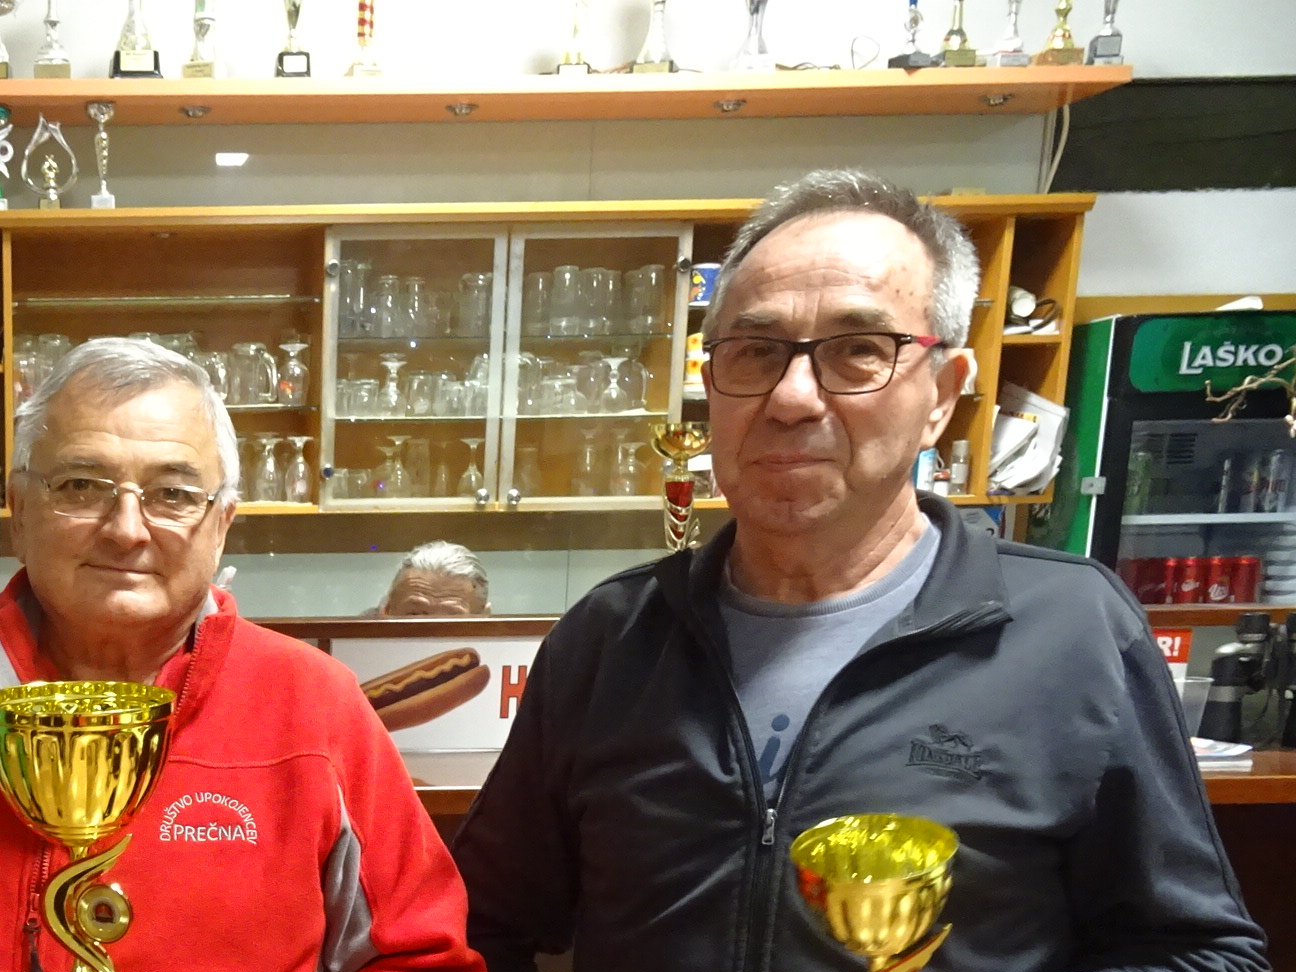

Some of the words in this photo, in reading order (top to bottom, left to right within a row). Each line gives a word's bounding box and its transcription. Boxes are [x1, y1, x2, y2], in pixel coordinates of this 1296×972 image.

[1178, 341, 1284, 375] LAŠKO
[159, 794, 193, 842] DRUŠTVO
[195, 792, 258, 845] UPOKOJENCEV
[173, 822, 246, 842] PREČNA
